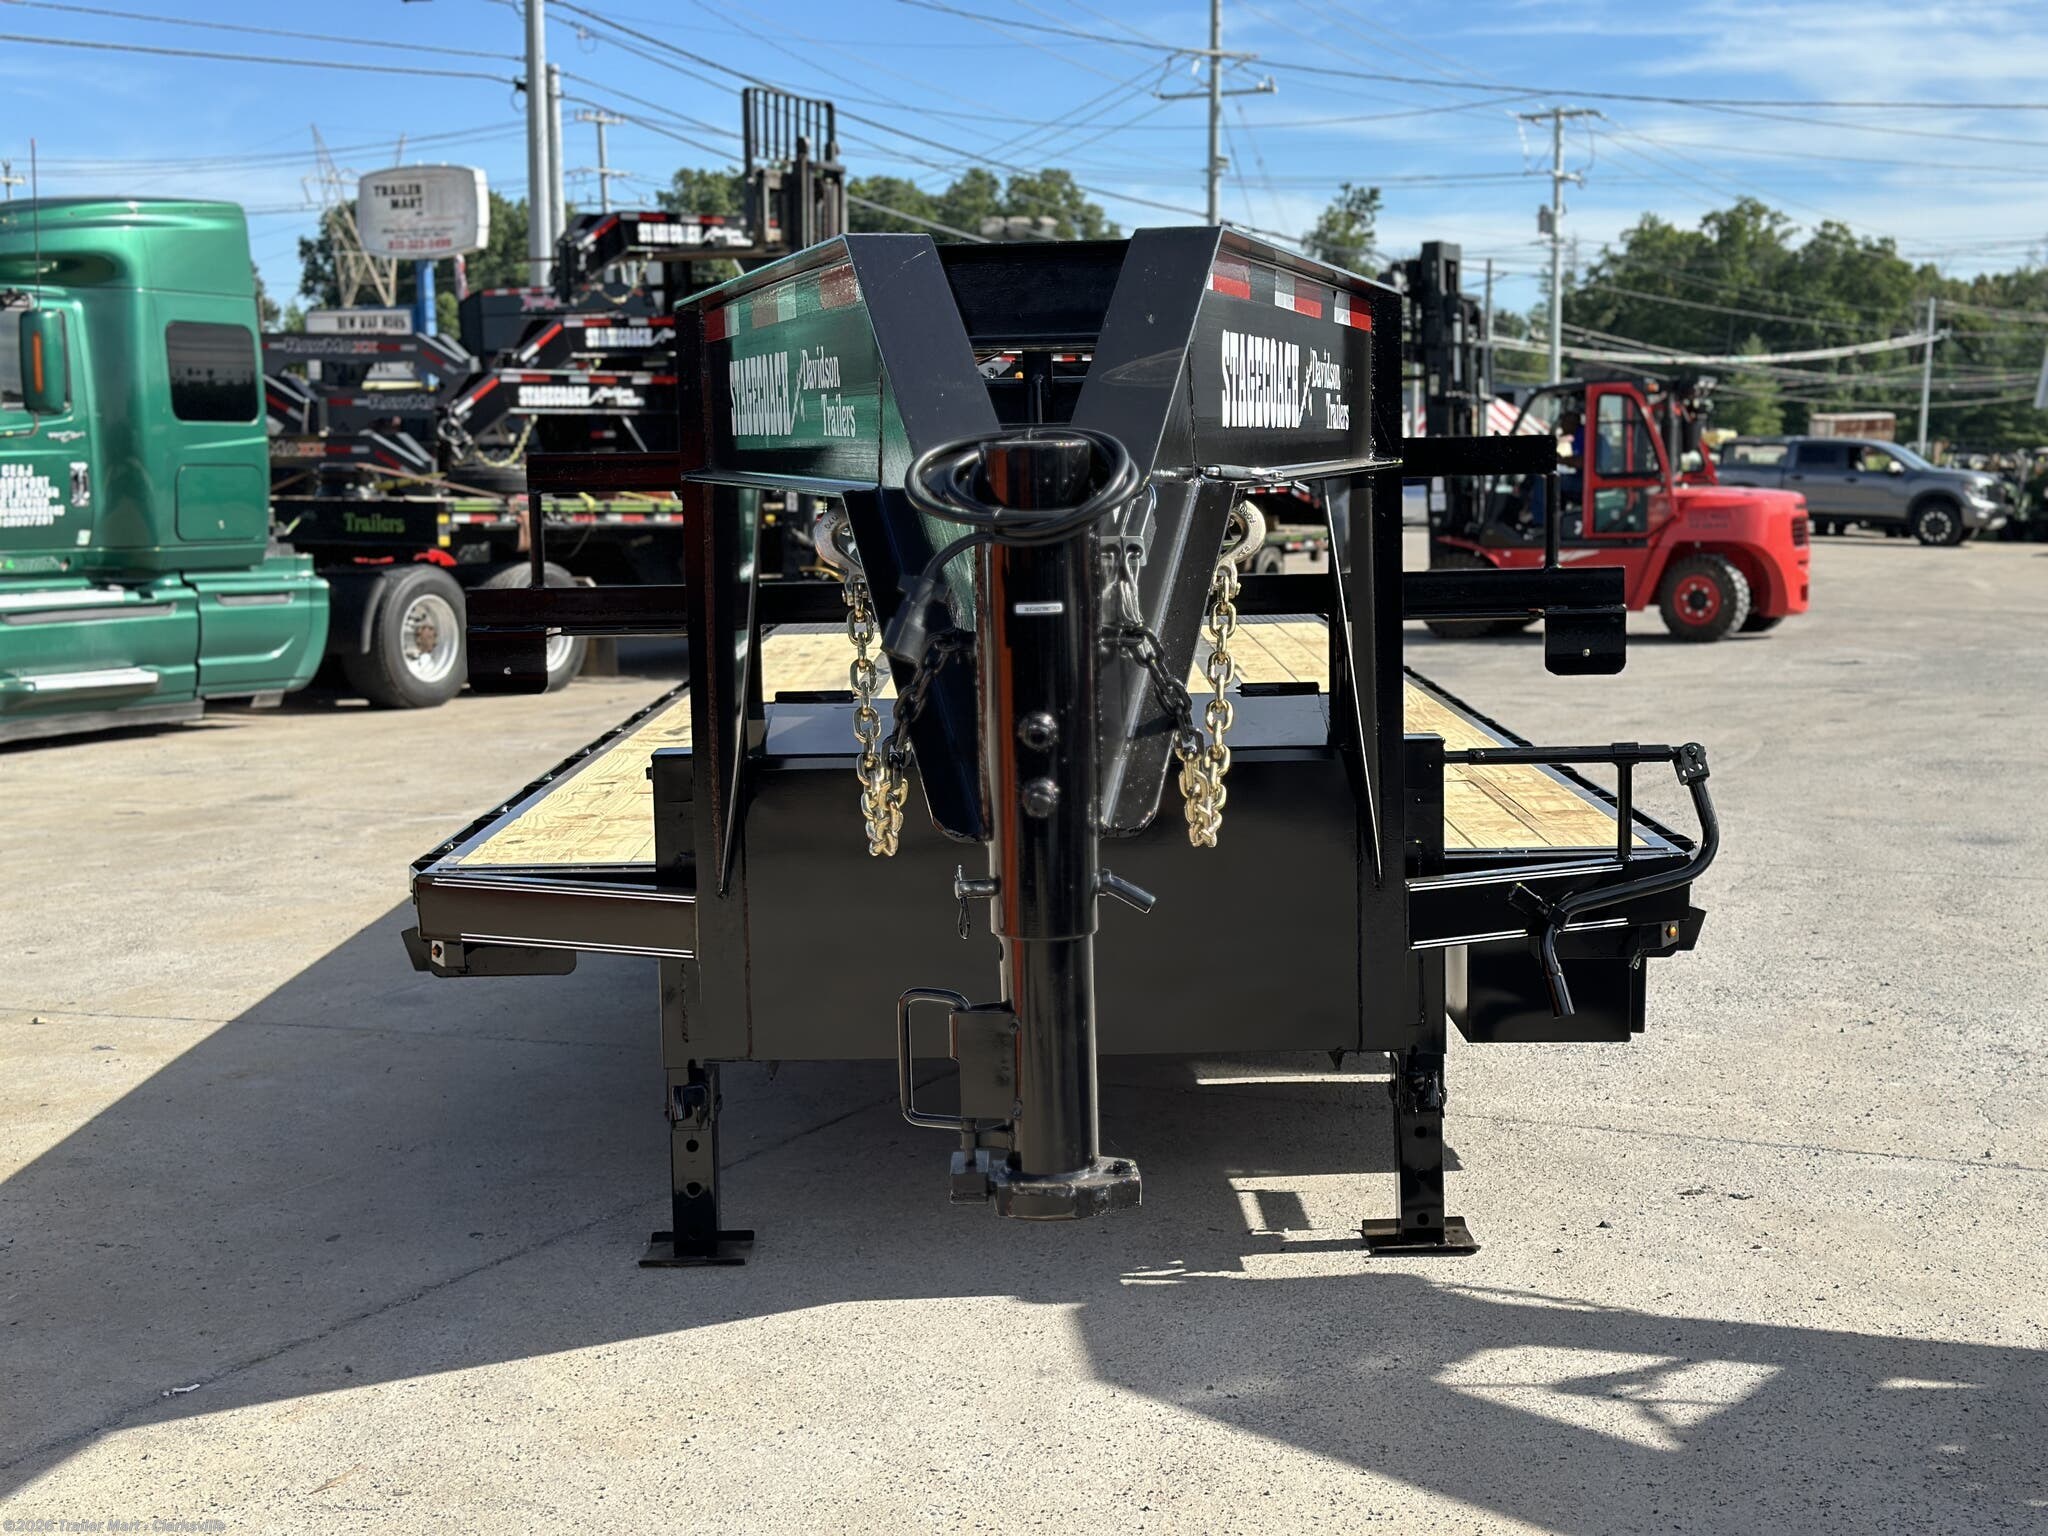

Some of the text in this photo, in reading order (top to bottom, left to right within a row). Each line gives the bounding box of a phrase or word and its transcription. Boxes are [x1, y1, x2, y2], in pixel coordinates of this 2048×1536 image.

[374, 184, 422, 197] TRAILER
[390, 197, 422, 210] MART
[801, 344, 841, 390] Davidson
[1222, 329, 1300, 429] STAGECOACH
[1311, 348, 1341, 390] Davidson
[730, 351, 791, 436] STAGECOACH
[1326, 392, 1350, 431] Trailers
[821, 393, 856, 438] Trailers
[344, 511, 405, 533] Trailers
